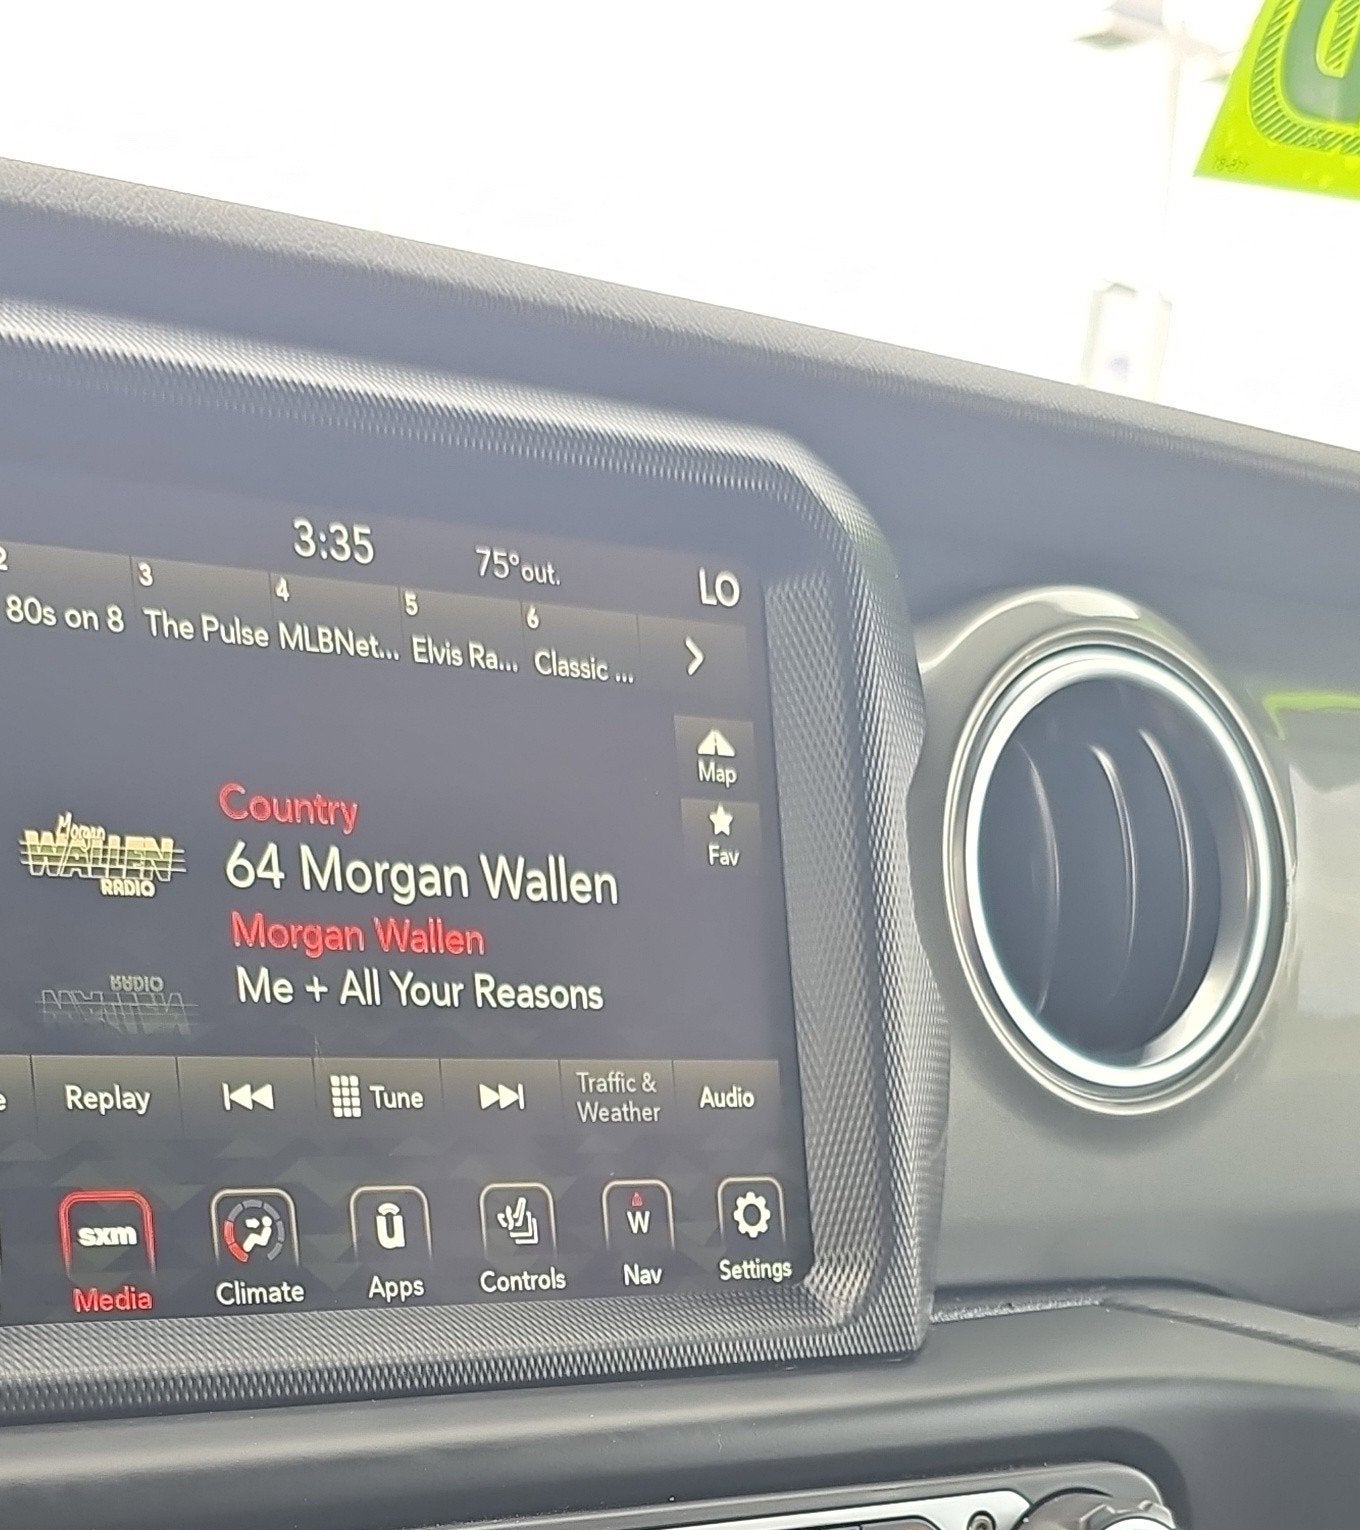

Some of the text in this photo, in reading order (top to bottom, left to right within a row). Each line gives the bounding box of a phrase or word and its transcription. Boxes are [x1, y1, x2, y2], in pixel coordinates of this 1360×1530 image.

[293, 517, 375, 564] 3:35
[139, 563, 154, 586] 3
[698, 568, 741, 607] LO
[276, 578, 290, 601] 4
[6, 594, 125, 633] 80s on 8
[404, 593, 418, 616] 5
[143, 607, 269, 648] The Pulse
[527, 607, 539, 629] 6
[412, 635, 463, 667] Elvis
[534, 650, 609, 681] Classic
[698, 761, 737, 788] Map
[218, 783, 358, 834] Country
[24, 829, 174, 881] WALLEN
[708, 845, 740, 867] Fav
[225, 840, 619, 906] 64 Morgan Wallen
[100, 878, 156, 897] RADIO
[230, 910, 485, 958] Morgan Wallen
[236, 965, 604, 1010] Me + All Your Reasons
[577, 1071, 657, 1094] Traffic &
[66, 1084, 151, 1115] Replay
[369, 1085, 424, 1110] Tune
[699, 1085, 755, 1109] Audio
[577, 1101, 661, 1124] Weather
[77, 1224, 138, 1247] sxm
[627, 1211, 650, 1234] W
[480, 1266, 566, 1293] Controls
[623, 1263, 663, 1287] Nav
[719, 1258, 793, 1284] Settings
[73, 1286, 153, 1313] Media
[216, 1281, 305, 1306] Climate
[368, 1276, 425, 1301] Apps
